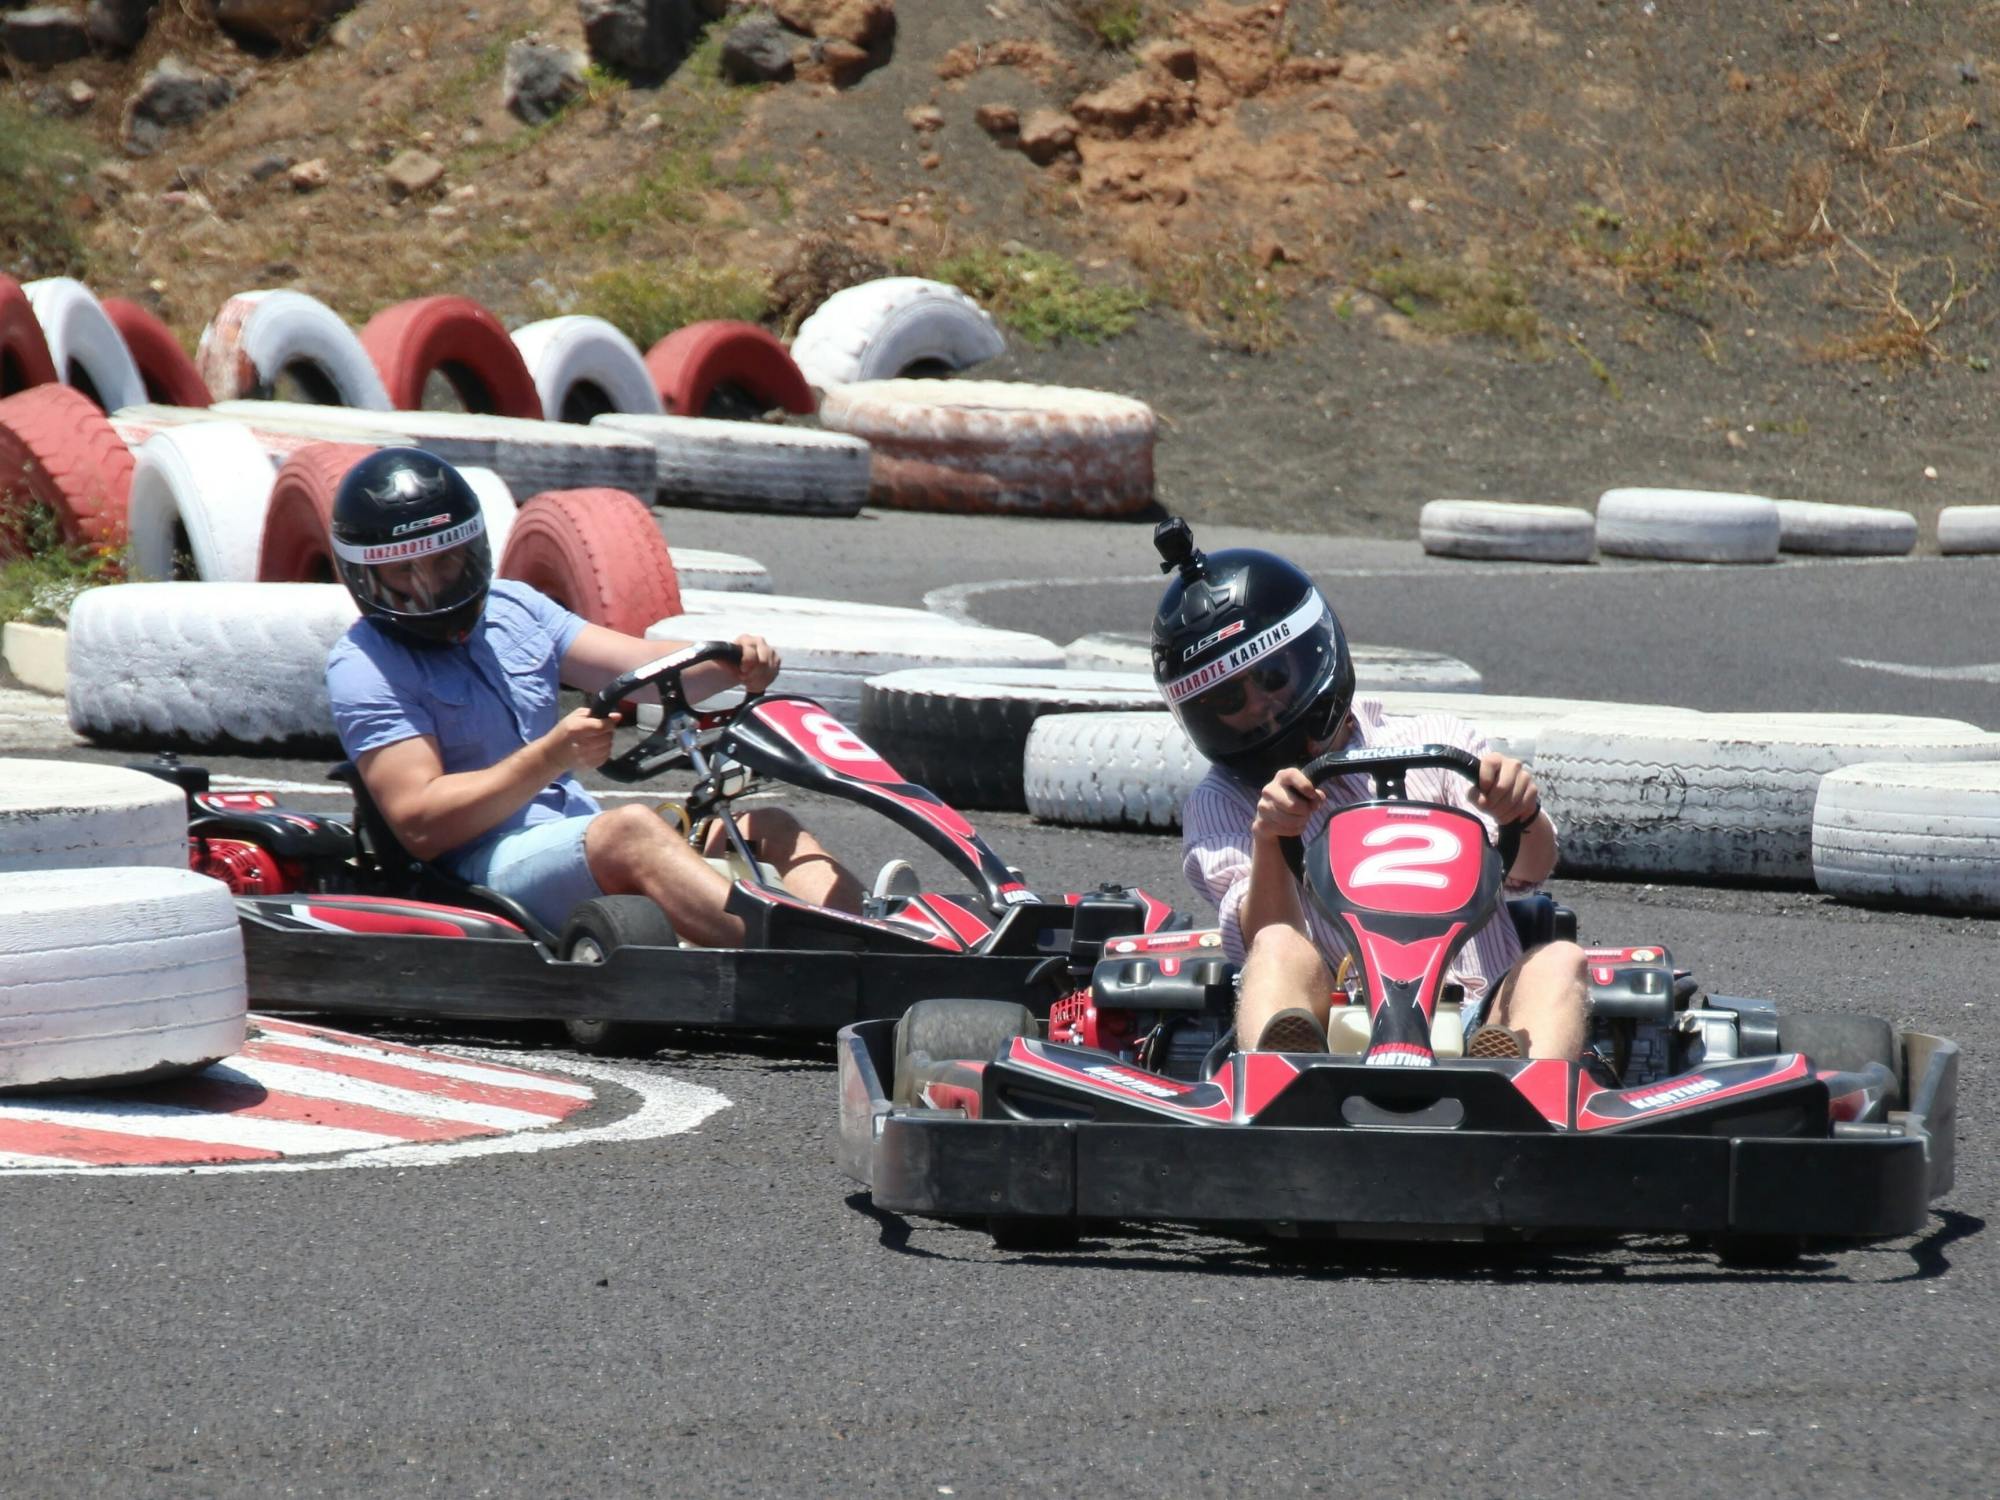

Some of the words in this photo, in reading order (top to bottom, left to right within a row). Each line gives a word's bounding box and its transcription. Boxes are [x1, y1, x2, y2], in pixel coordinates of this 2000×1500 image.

[364, 537, 432, 560] LANZAROTE
[438, 518, 479, 545] KARTING
[1184, 620, 1246, 662] LS2
[1229, 623, 1290, 668] KARTING
[801, 713, 882, 762] 8
[1349, 823, 1461, 889] 2
[1365, 1052, 1432, 1067] KARTING
[1629, 1080, 1722, 1109] KARTING
